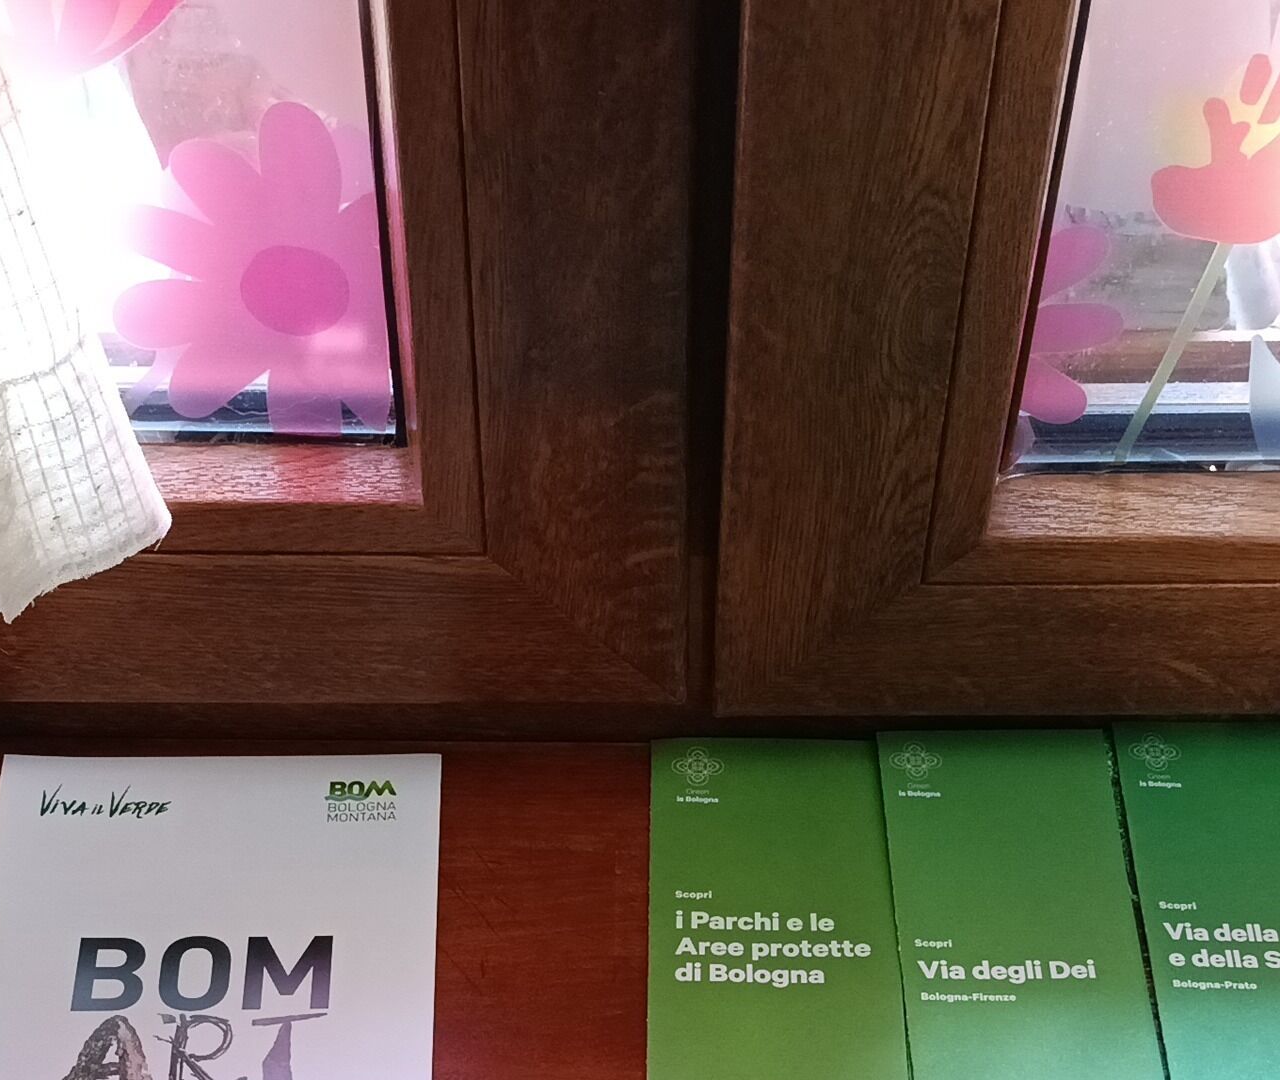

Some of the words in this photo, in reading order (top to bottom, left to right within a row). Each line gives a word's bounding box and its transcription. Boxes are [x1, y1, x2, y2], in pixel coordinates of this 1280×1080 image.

[329, 780, 397, 797] BOM
[327, 801, 396, 812] BOLOGNA
[327, 811, 396, 823] MONTANA
[675, 890, 713, 900] Scopri
[1158, 901, 1197, 911] Scopri
[675, 910, 684, 929] i
[690, 911, 780, 931] Parchi
[786, 916, 803, 932] e
[810, 912, 835, 932] le
[1162, 921, 1210, 942] Via
[1213, 923, 1279, 943] della
[675, 937, 744, 956] Aree
[752, 939, 872, 961] protette
[914, 938, 953, 950] Scopri
[1169, 951, 1186, 968] e
[1191, 949, 1259, 969] della
[70, 934, 334, 1012] BOM
[674, 962, 702, 982] di
[709, 963, 825, 988] Bologna
[917, 959, 966, 980] Via
[971, 959, 1043, 985] degli
[1048, 958, 1097, 979] Dei
[1172, 979, 1258, 991] Bologna-Prato
[920, 992, 1017, 1003] Bologna-Firenze
